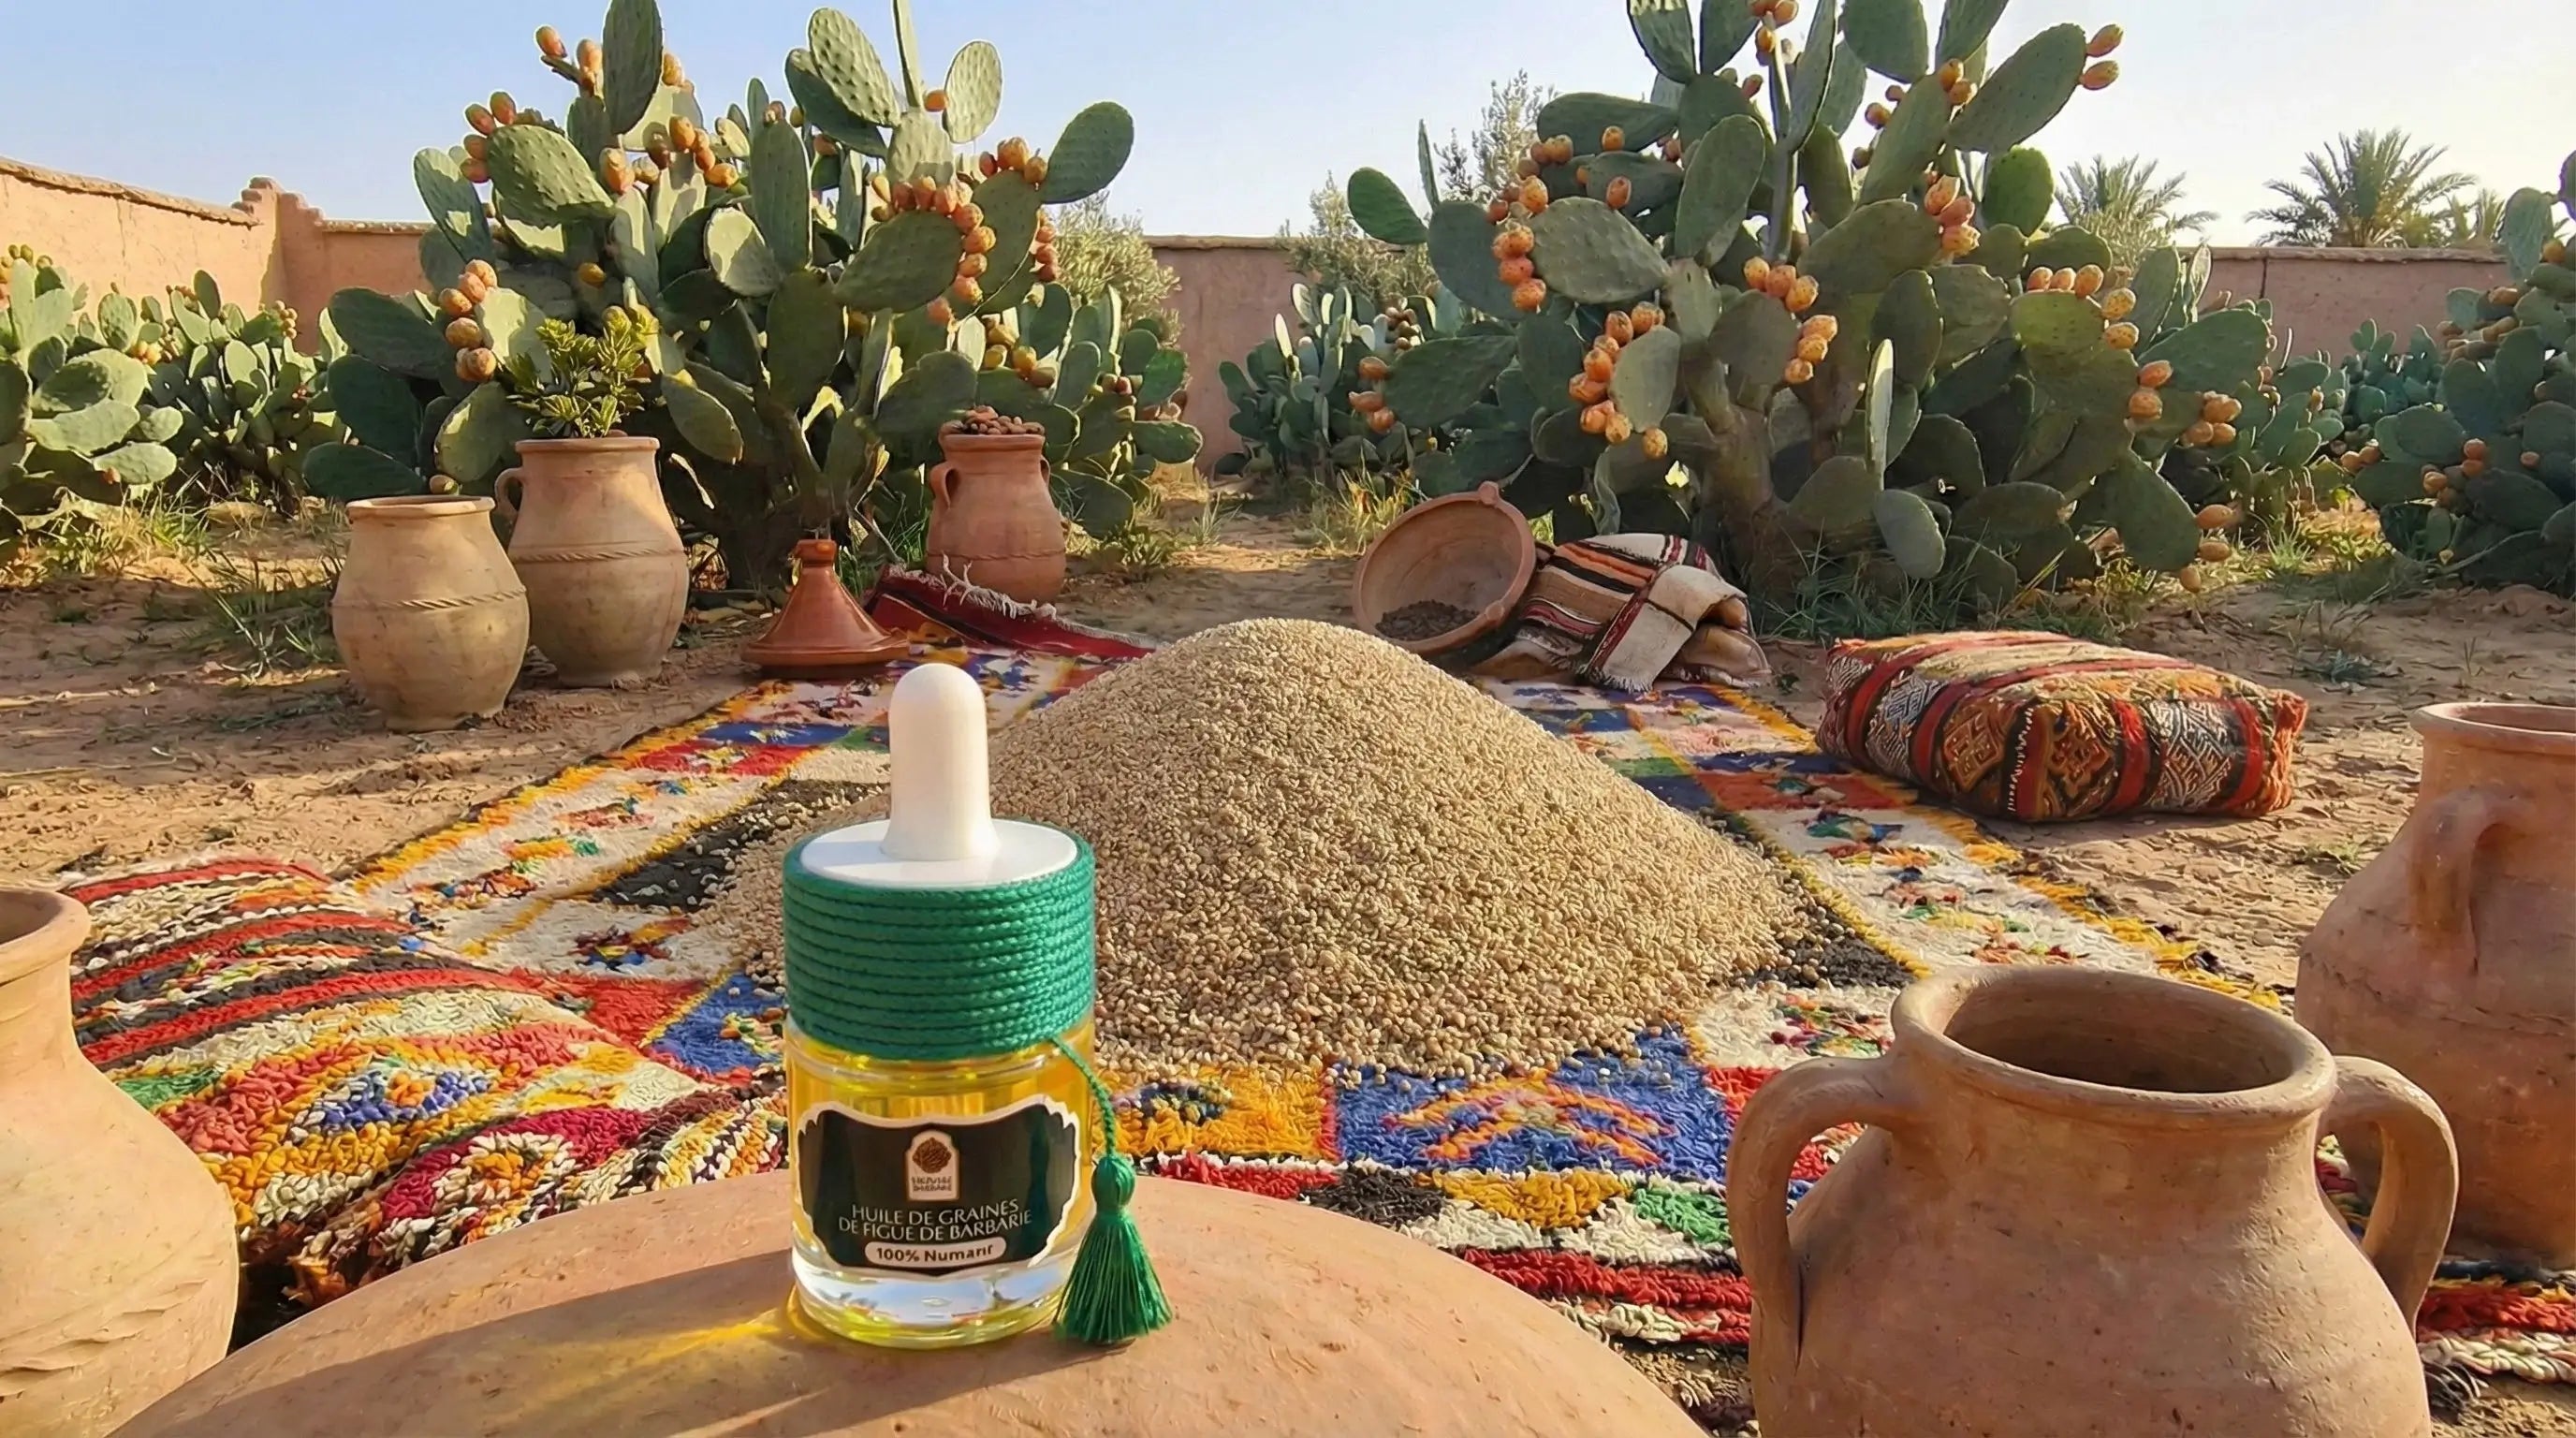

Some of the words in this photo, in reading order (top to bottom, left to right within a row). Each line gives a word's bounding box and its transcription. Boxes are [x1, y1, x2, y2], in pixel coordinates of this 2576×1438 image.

[839, 1216, 858, 1235] DE
[863, 1224, 916, 1241] FIGUE
[919, 1225, 944, 1241] DE
[949, 1209, 1032, 1240] BARBARIE
[852, 1204, 903, 1225] HUILE
[909, 1211, 935, 1225] DE
[938, 1198, 1019, 1225] GRAINES
[876, 1247, 920, 1262] 100%
